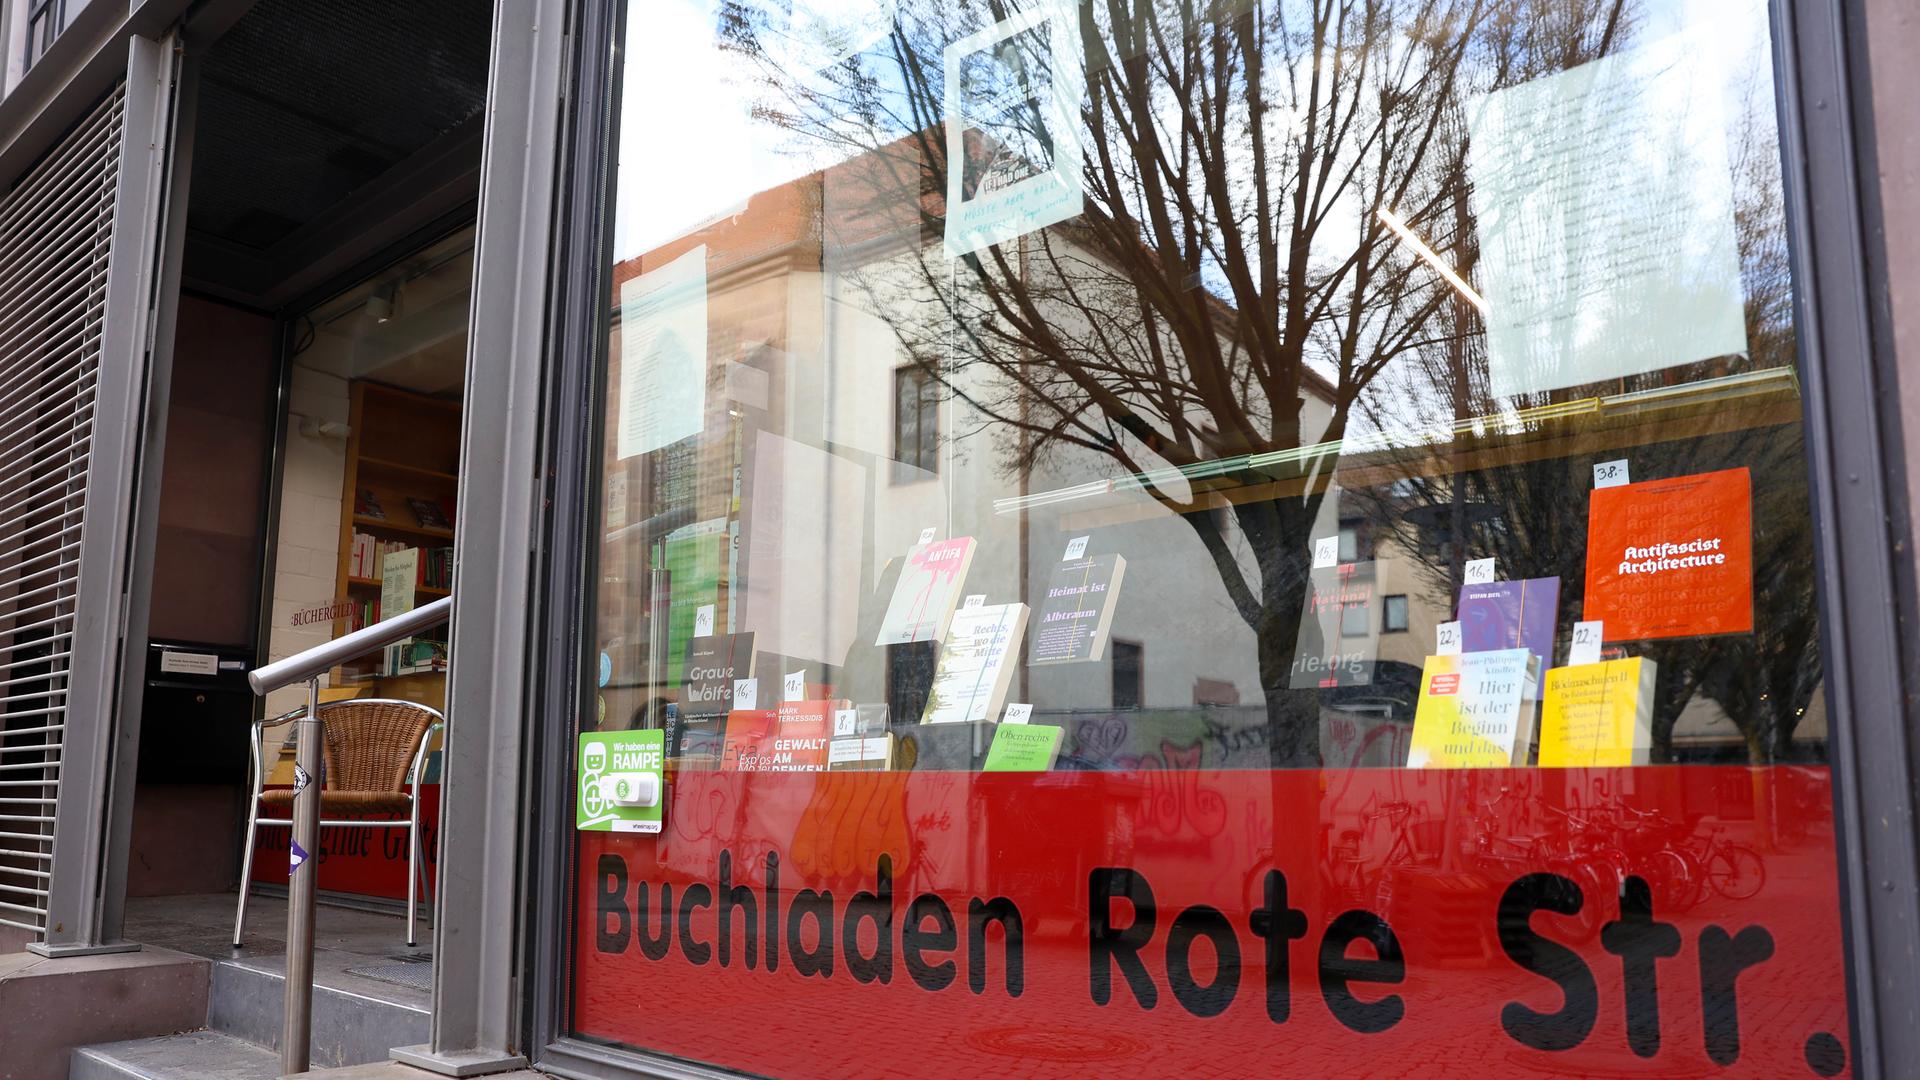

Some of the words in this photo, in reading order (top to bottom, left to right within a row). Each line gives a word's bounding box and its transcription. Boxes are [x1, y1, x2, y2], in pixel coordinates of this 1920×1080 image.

[928, 547, 961, 562] ANTIFA
[1624, 537, 1721, 561] Antifascist
[1468, 564, 1490, 579] 16,-
[1618, 553, 1726, 575] Architecture
[1048, 585, 1088, 598] Heimat
[1091, 582, 1107, 593] ist
[1043, 609, 1097, 623] Albtraum
[974, 638, 989, 647] wo
[1440, 629, 1461, 646] 22,-
[1575, 628, 1598, 647] 22,-
[690, 666, 735, 681] Graue
[687, 682, 732, 702] Wölfe
[735, 683, 752, 699] 16,-
[785, 679, 801, 693] 18,-
[1479, 680, 1516, 695] Hier
[778, 707, 799, 715] MARK
[1458, 701, 1478, 715] ist
[1483, 700, 1513, 714] der
[778, 714, 823, 723] TERKESSIDIS
[1451, 720, 1509, 736] Beginn
[1000, 730, 1023, 741] Oben
[1024, 733, 1050, 742] rechts
[613, 743, 625, 751] Wir
[625, 743, 645, 751] haben
[774, 738, 827, 751] GEWALT
[1443, 740, 1475, 755] und
[1477, 738, 1506, 754] das
[613, 752, 660, 770] RAMPE
[772, 753, 792, 764] AM
[596, 848, 1025, 998] Buchladen
[1088, 867, 1407, 1034] Rote
[1498, 872, 1846, 1078] Str.
